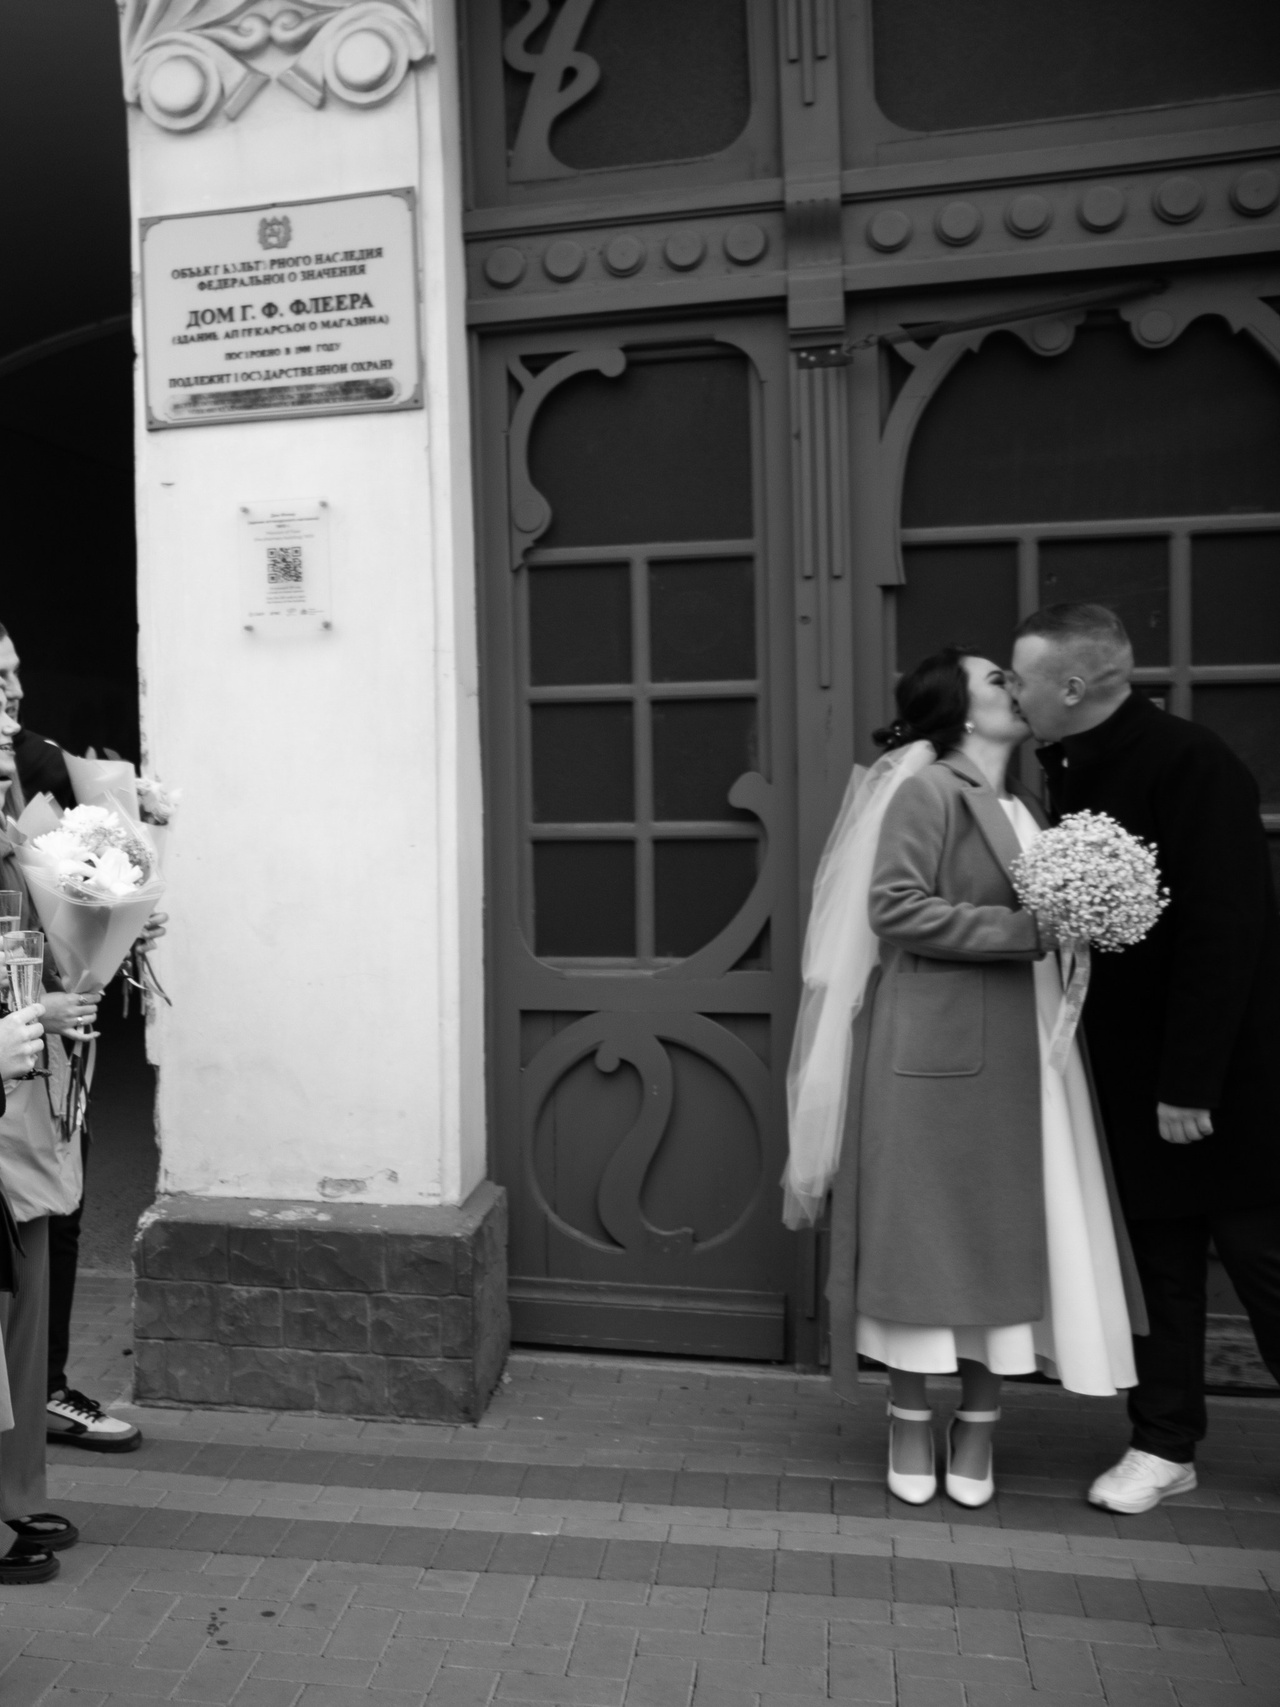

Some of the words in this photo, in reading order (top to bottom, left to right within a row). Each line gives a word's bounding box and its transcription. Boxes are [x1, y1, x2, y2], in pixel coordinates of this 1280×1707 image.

[171, 265, 220, 280] ОБЪЕКТ
[315, 247, 384, 265] НАСЛЕДИЯ
[197, 272, 297, 291] ФЕДЕРАЛЬНОГО
[300, 264, 366, 281] ЗНАЧЕНИЯ
[186, 307, 234, 329] ДОМ
[241, 305, 256, 321] Г.
[261, 302, 284, 318] Ф.
[289, 293, 373, 315] ФЛЕЕРА
[223, 321, 318, 339] АПТЕКАРСКОГО
[321, 315, 390, 329] МАГАЗИНА)
[225, 348, 280, 361] ПОСТРОЕНО
[285, 347, 291, 355] В
[316, 342, 341, 352] ГОДУ
[169, 373, 231, 388] ПОДЛЕЖИТ
